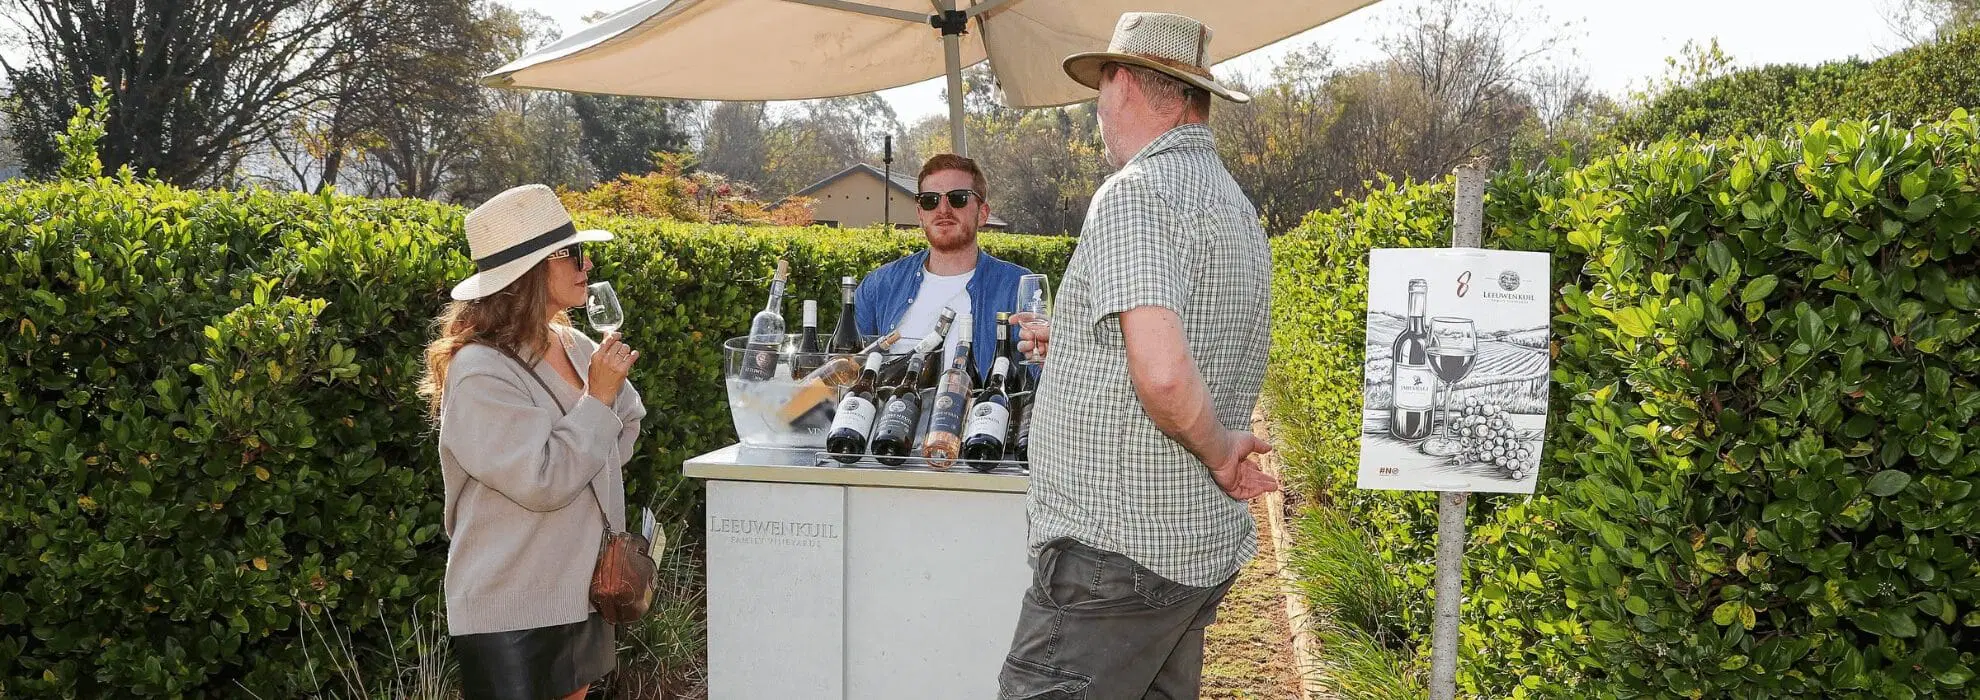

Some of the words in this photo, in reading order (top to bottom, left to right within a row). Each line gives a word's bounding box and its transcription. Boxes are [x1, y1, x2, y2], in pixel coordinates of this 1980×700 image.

[1456, 270, 1472, 298] 8
[1483, 291, 1535, 301] LEEUWENKUIL
[710, 515, 838, 539] LEEUWENKUIL
